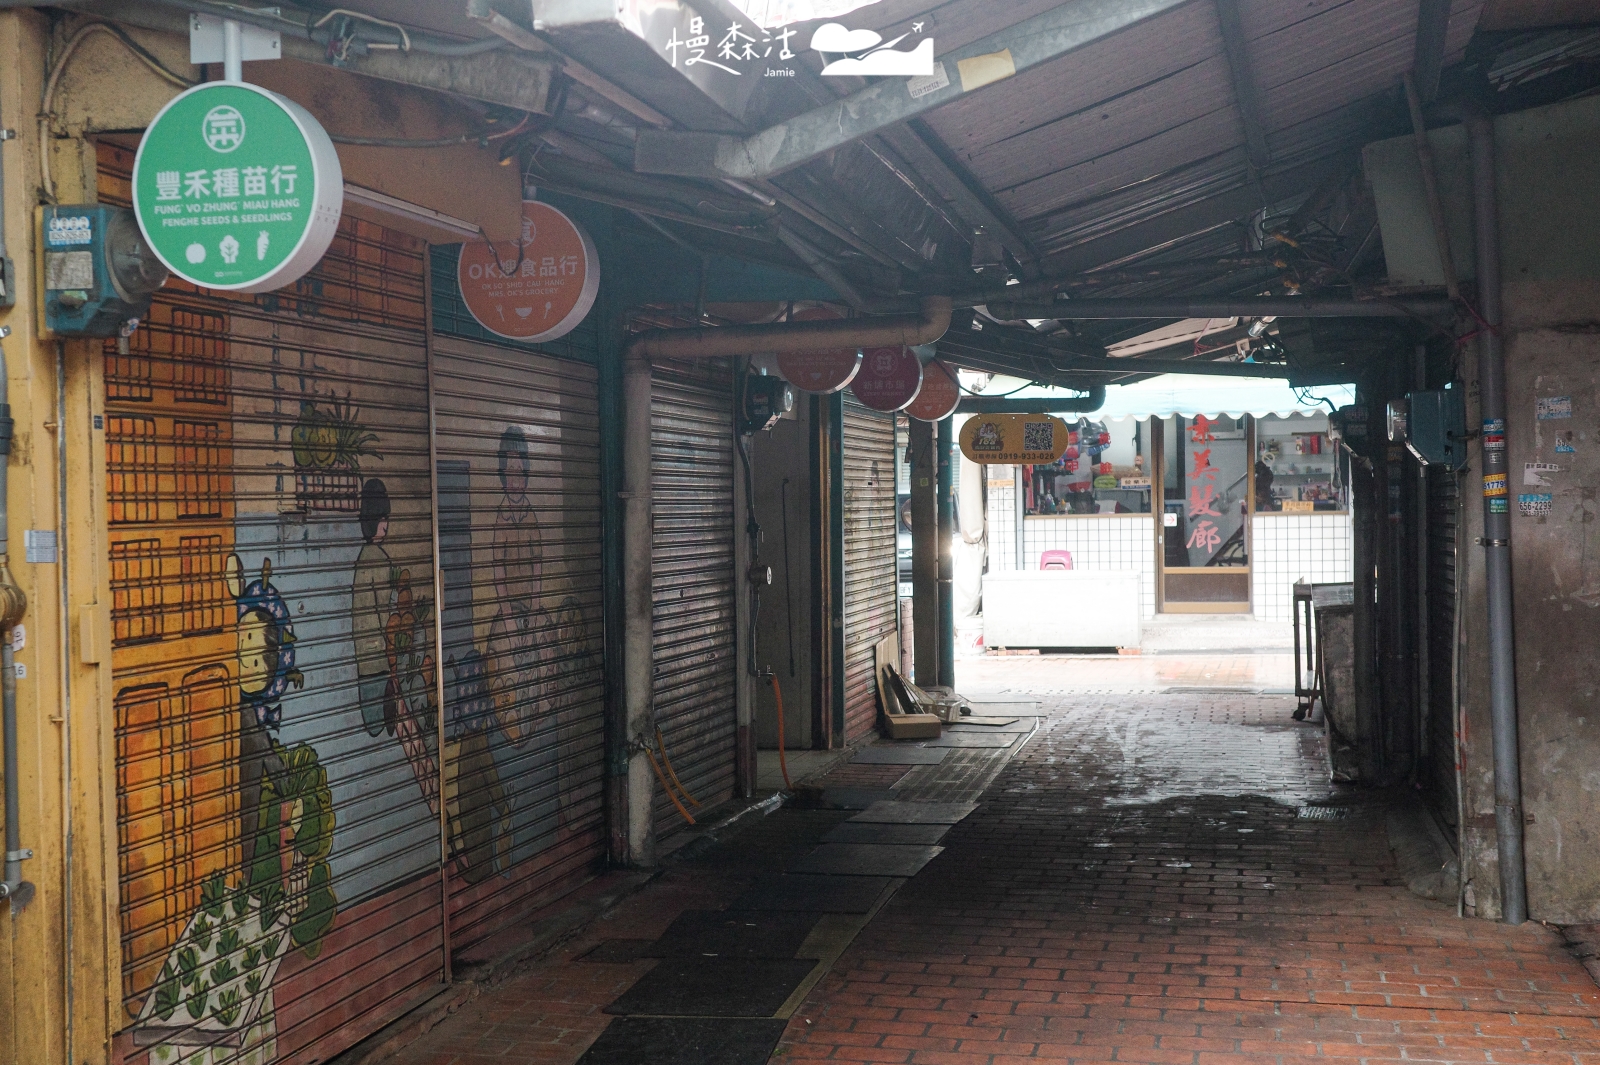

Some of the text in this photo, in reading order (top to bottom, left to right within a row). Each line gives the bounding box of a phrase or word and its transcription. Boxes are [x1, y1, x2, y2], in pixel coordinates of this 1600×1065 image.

[156, 164, 298, 200] 豐禾種苗行
[186, 203, 201, 213] VO
[243, 199, 269, 210] MIAU
[271, 198, 300, 208] HANG
[162, 212, 292, 227] FENGHE SEEDS & SEEDLINGS
[488, 290, 505, 298] MRS.
[525, 287, 559, 296] GROCERY
[1519, 501, 1552, 511] 656-2299
